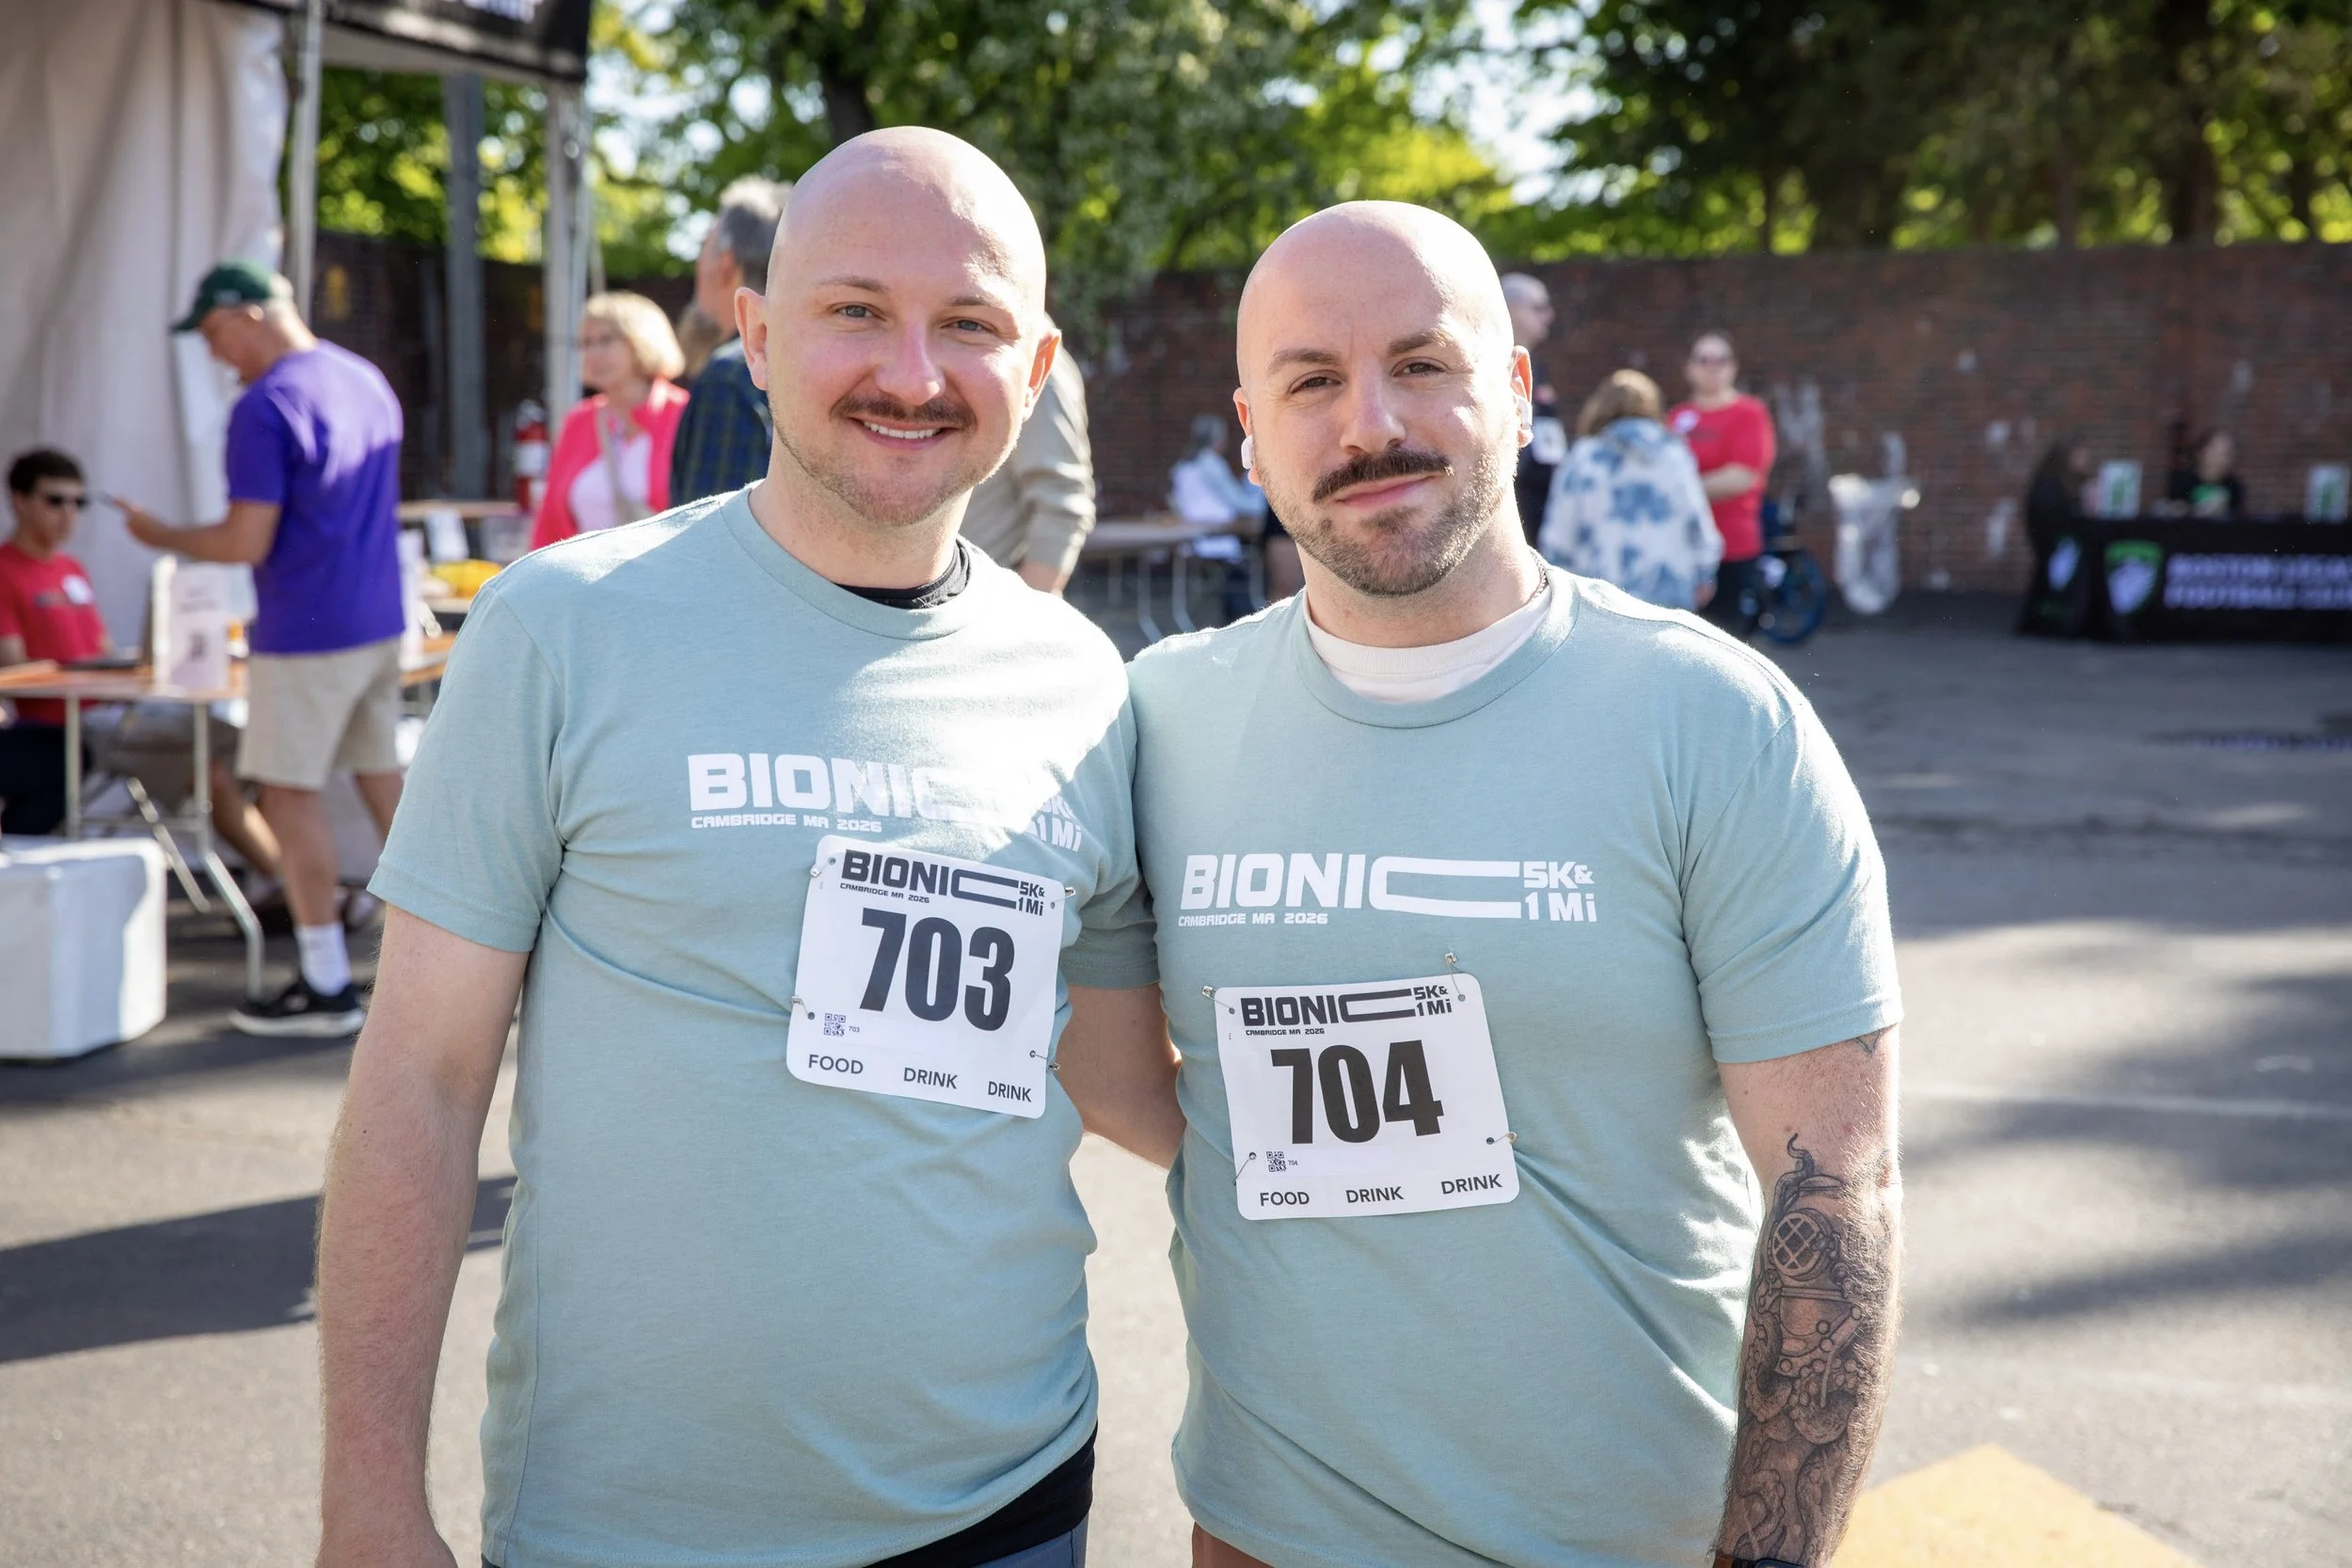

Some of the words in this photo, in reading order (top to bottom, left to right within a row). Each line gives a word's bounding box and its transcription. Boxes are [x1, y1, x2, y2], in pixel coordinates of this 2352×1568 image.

[691, 813, 797, 829] CAMBRIDGE
[803, 815, 830, 829] MA
[836, 818, 882, 832] 2026
[841, 849, 1020, 910] BIONIC
[1019, 880, 1045, 898] 5K&
[1180, 853, 1522, 919] BIONIC
[1523, 861, 1596, 890] 5K&
[839, 882, 889, 896] CAMBRIDGE
[890, 891, 904, 899] MA
[908, 895, 930, 904] 2026
[1178, 912, 1247, 927] CAMBRIDGE
[1252, 913, 1276, 925] MA
[1284, 913, 1328, 925] 2026
[859, 907, 1016, 1032] 703
[1240, 988, 1416, 1027] BIONIC
[1414, 985, 1449, 1002] 5K&
[808, 1053, 864, 1075] FOOD
[903, 1067, 959, 1089] DRINK
[988, 1081, 1032, 1102] DRINK
[1270, 1039, 1445, 1145] 704
[1259, 1190, 1311, 1207] FOOD
[1345, 1185, 1405, 1204] DRINK
[1440, 1173, 1503, 1196] DRINK
